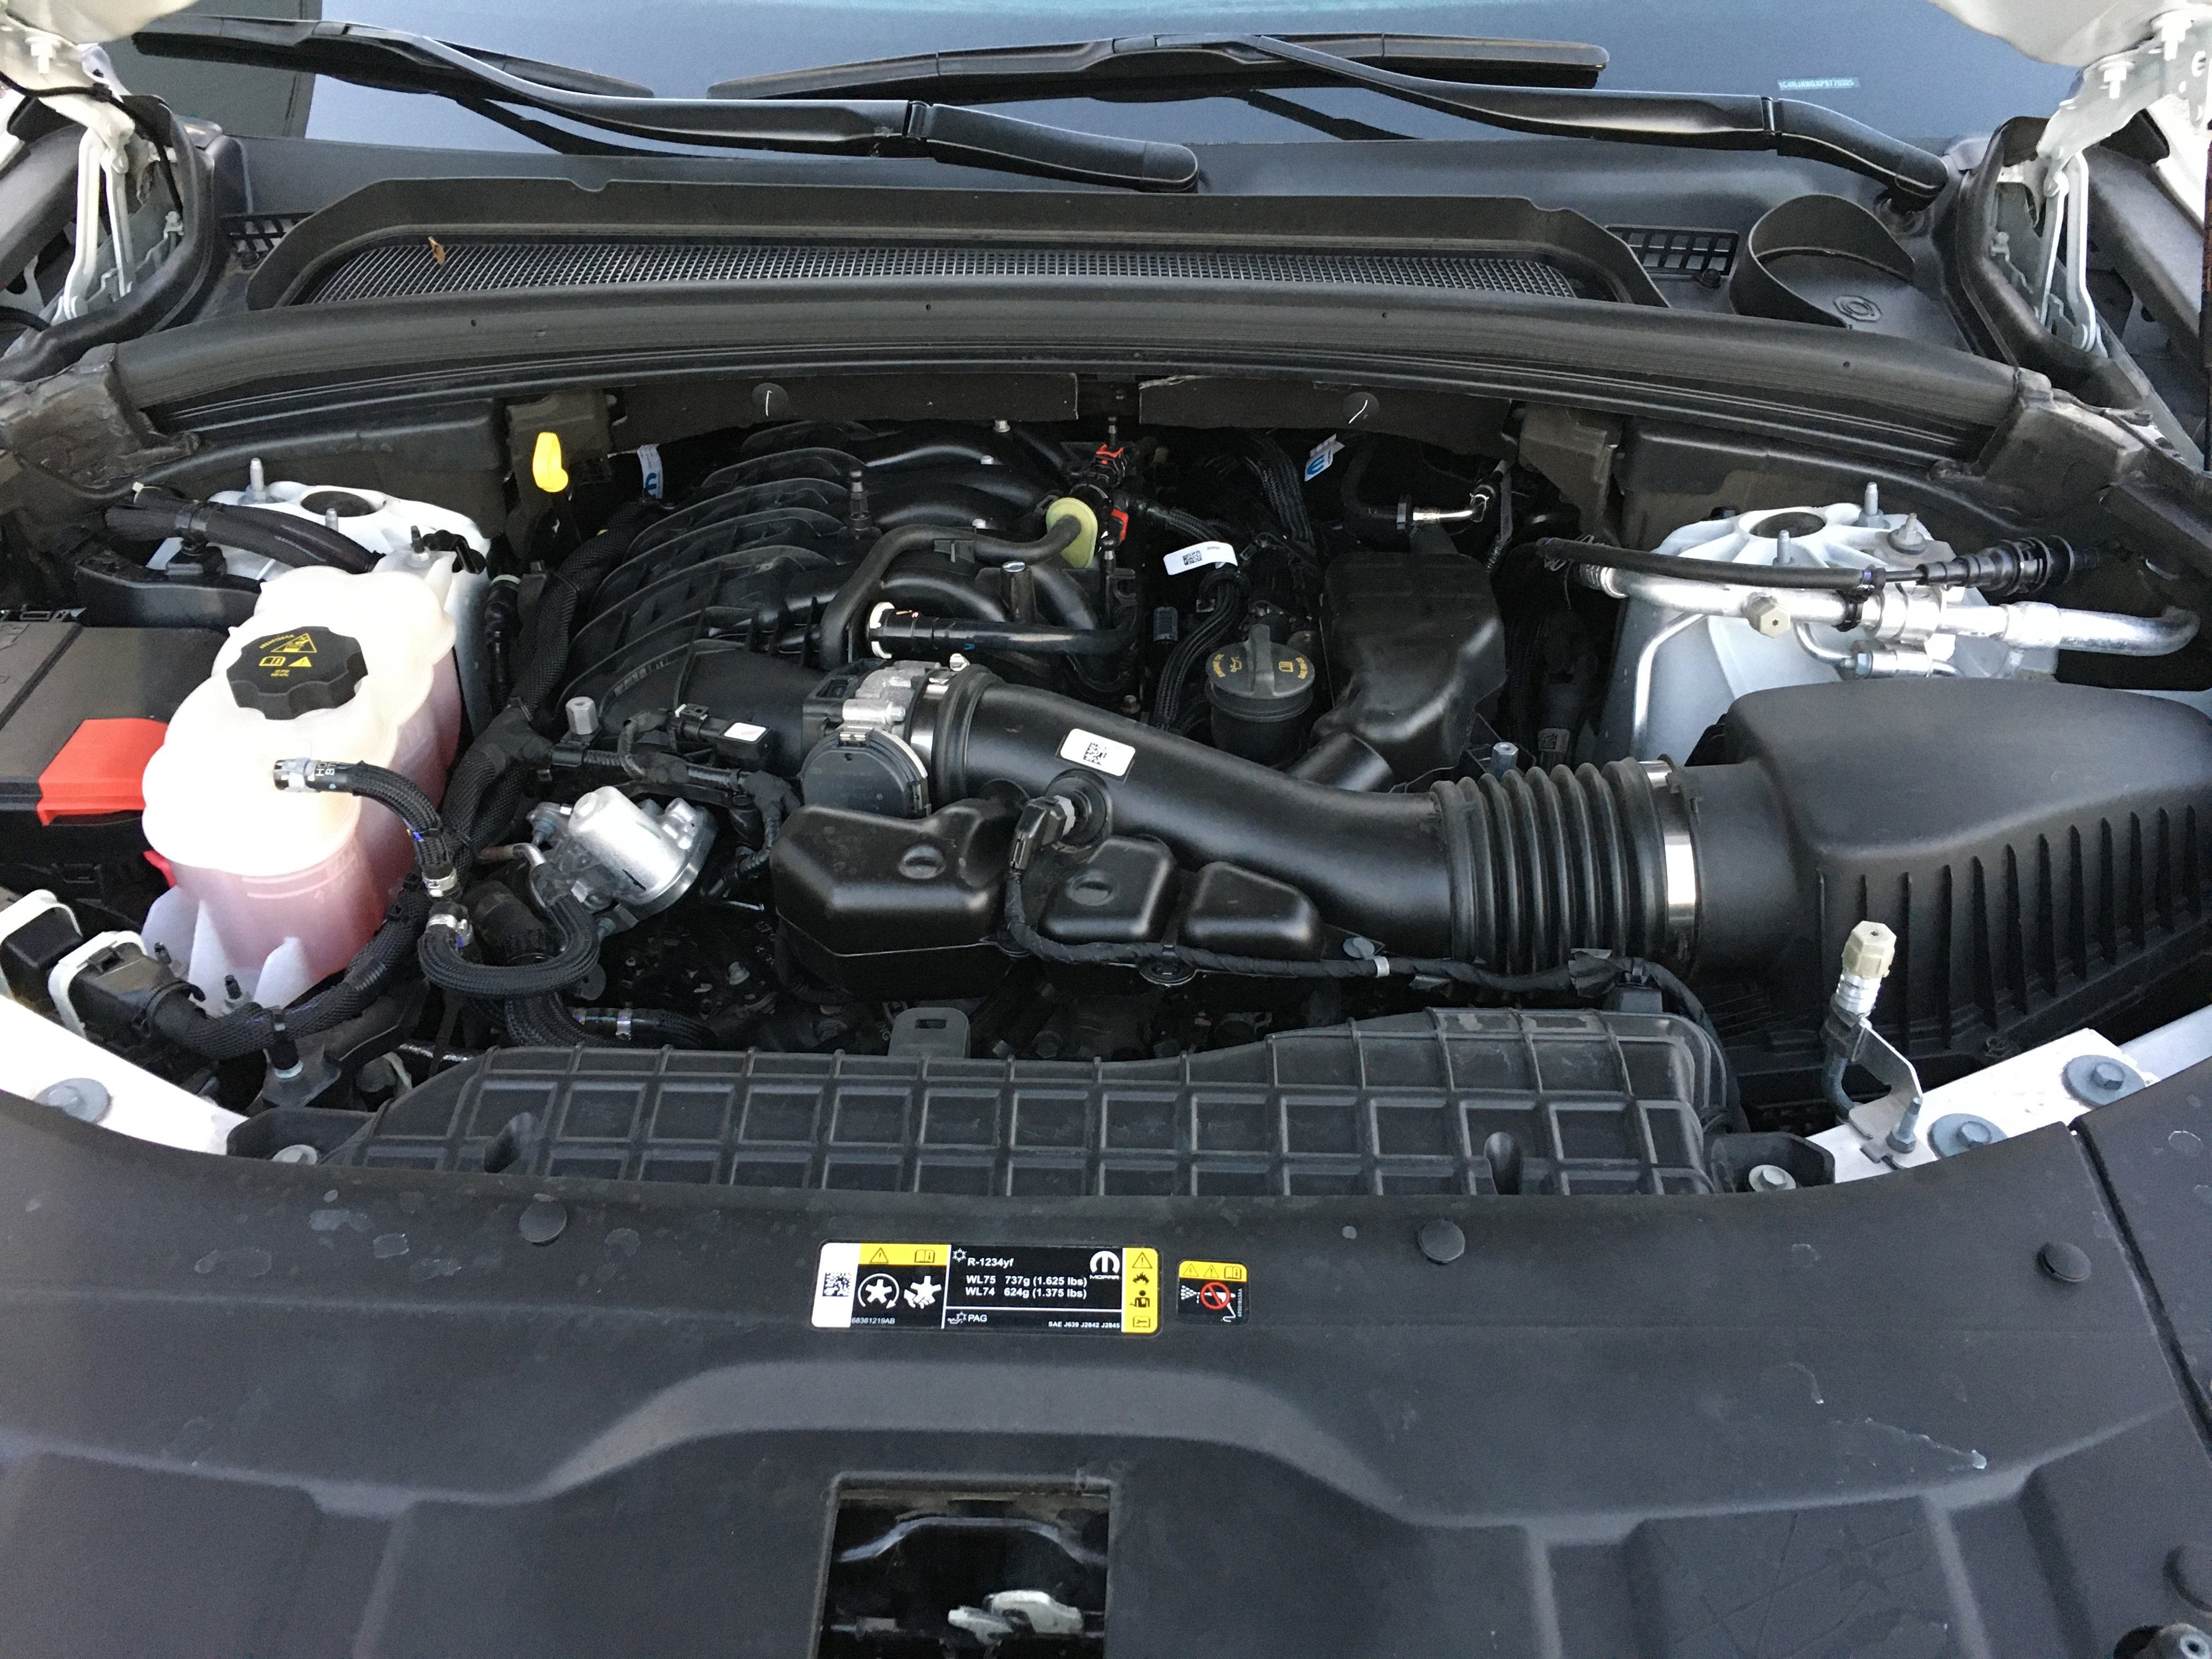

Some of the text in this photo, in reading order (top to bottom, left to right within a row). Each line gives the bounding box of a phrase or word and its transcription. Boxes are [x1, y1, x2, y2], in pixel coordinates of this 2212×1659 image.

[967, 1257, 1014, 1269] R-1234yf
[966, 1275, 1087, 1288] WL75 737g (1.625 lbs)
[965, 1286, 1087, 1300] WL74 624g (1.375 lbs)
[968, 1314, 988, 1322] PAG
